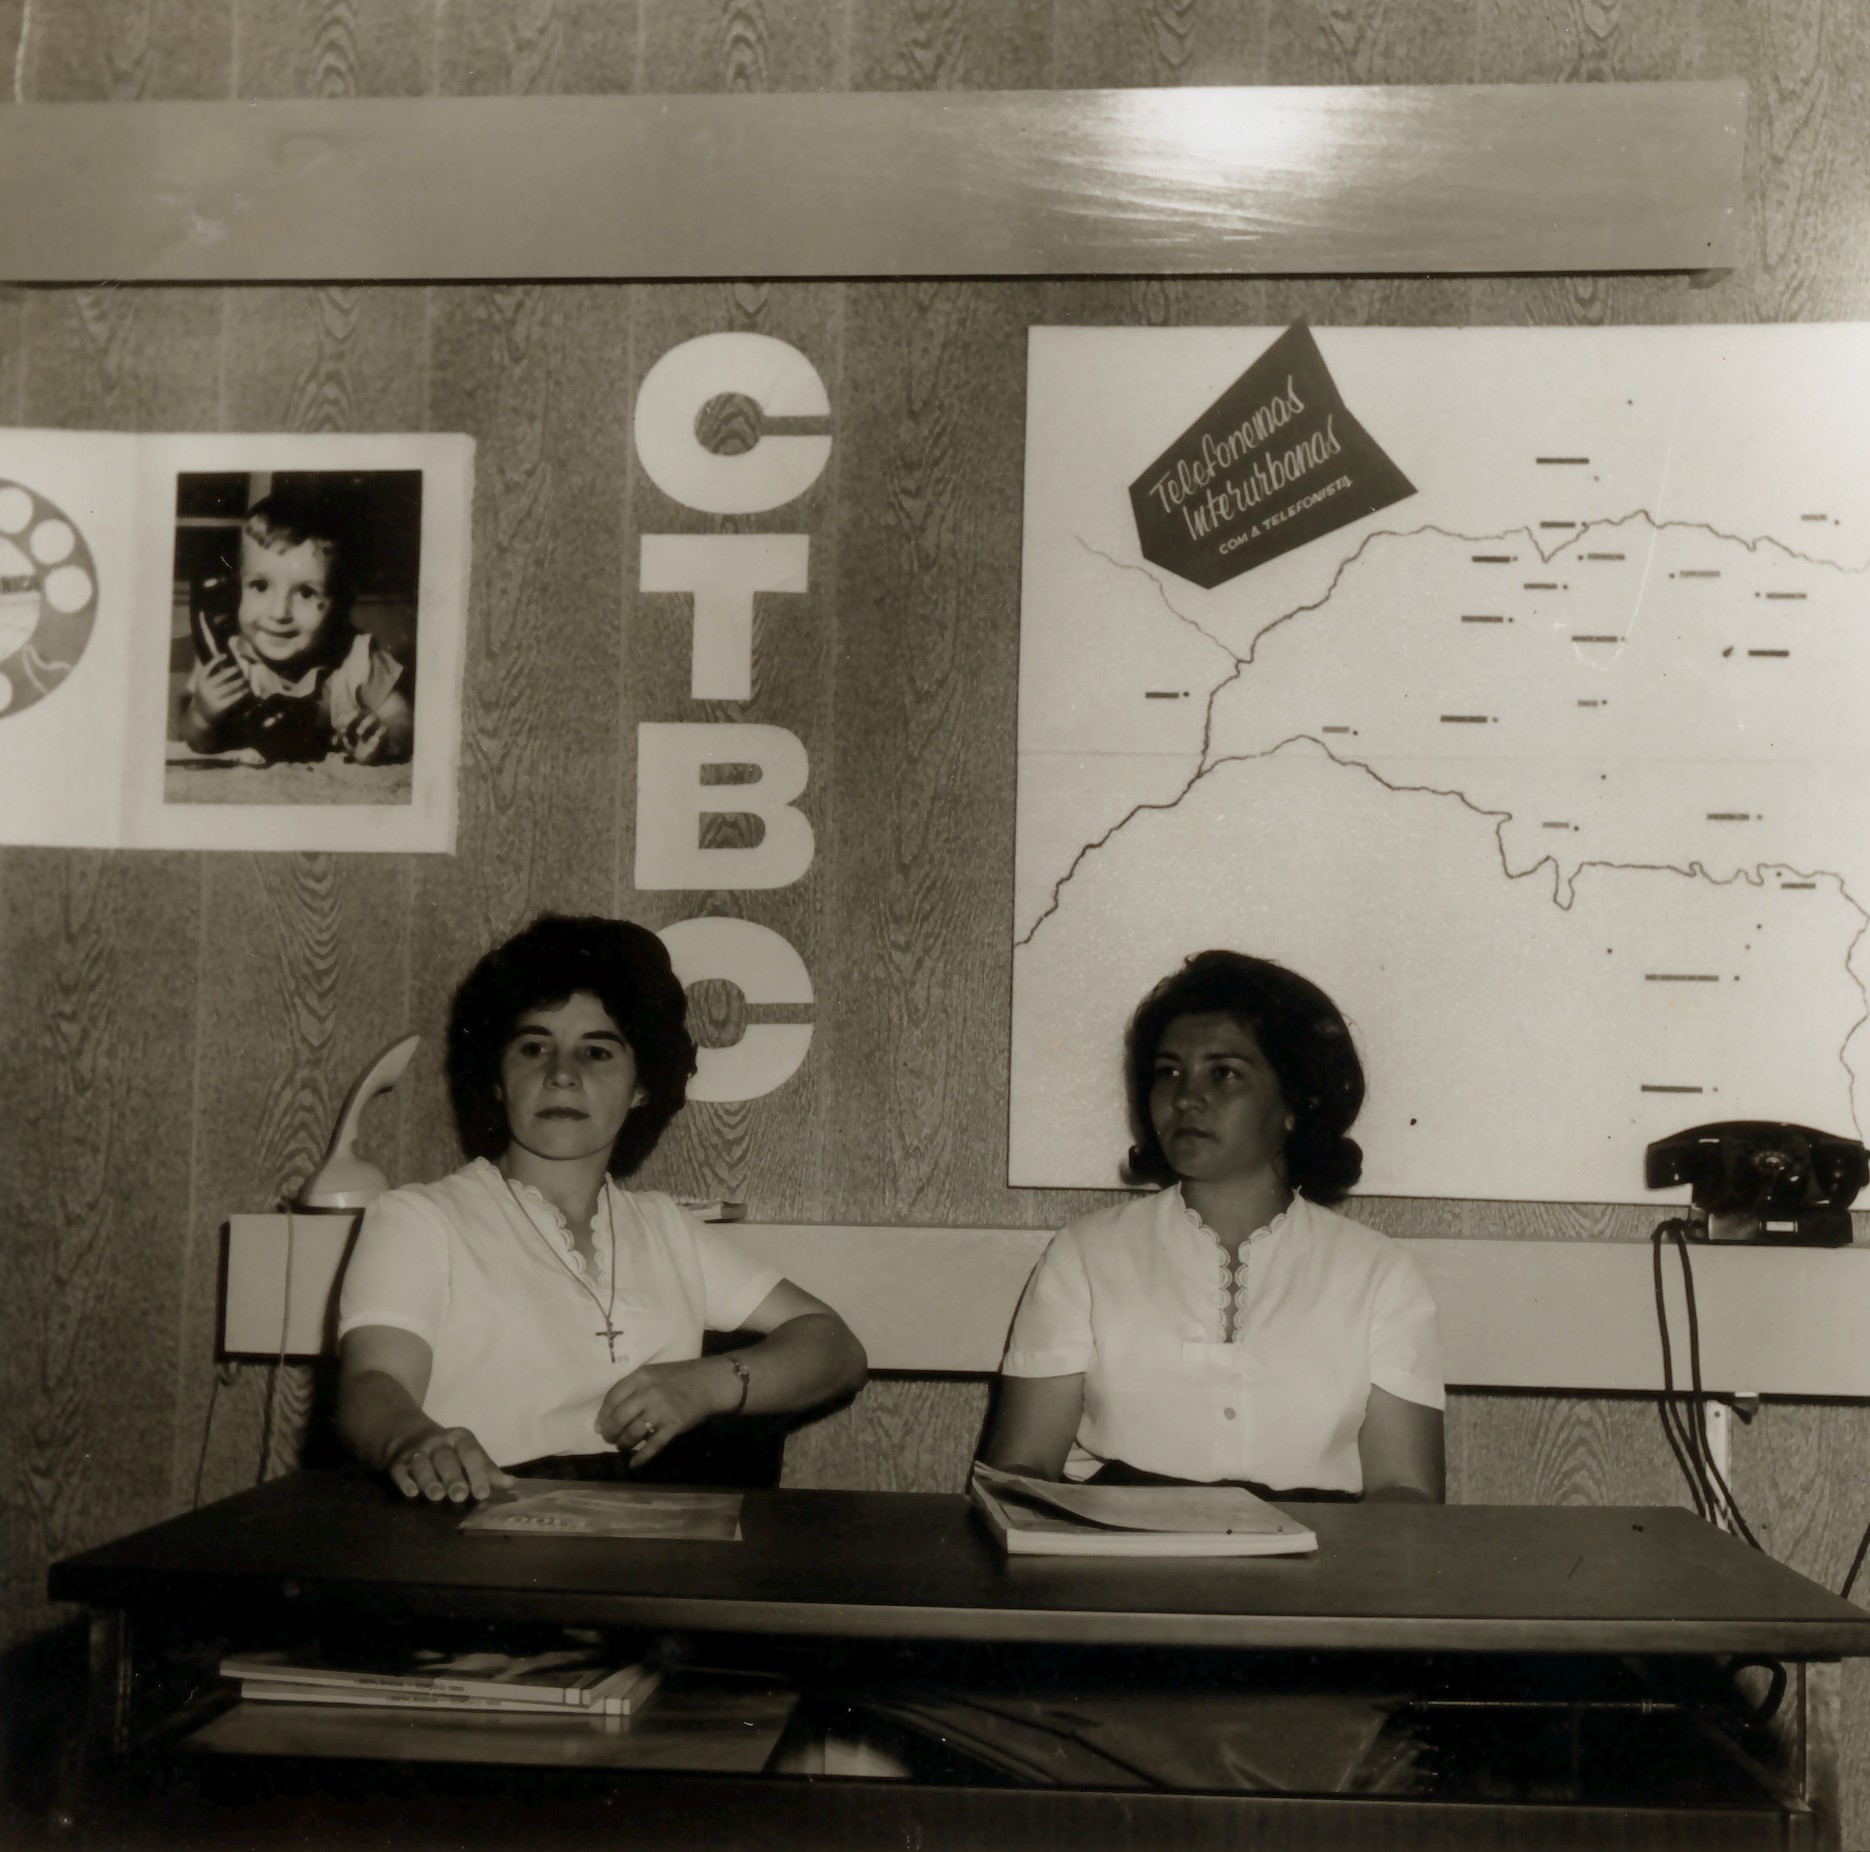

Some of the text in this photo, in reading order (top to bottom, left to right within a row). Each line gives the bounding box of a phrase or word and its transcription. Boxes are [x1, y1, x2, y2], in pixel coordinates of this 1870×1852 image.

[1149, 374, 1305, 514] Telefonemas
[1182, 413, 1342, 542] Interurbanas
[1218, 475, 1353, 555] COM A TELEFONISTA
